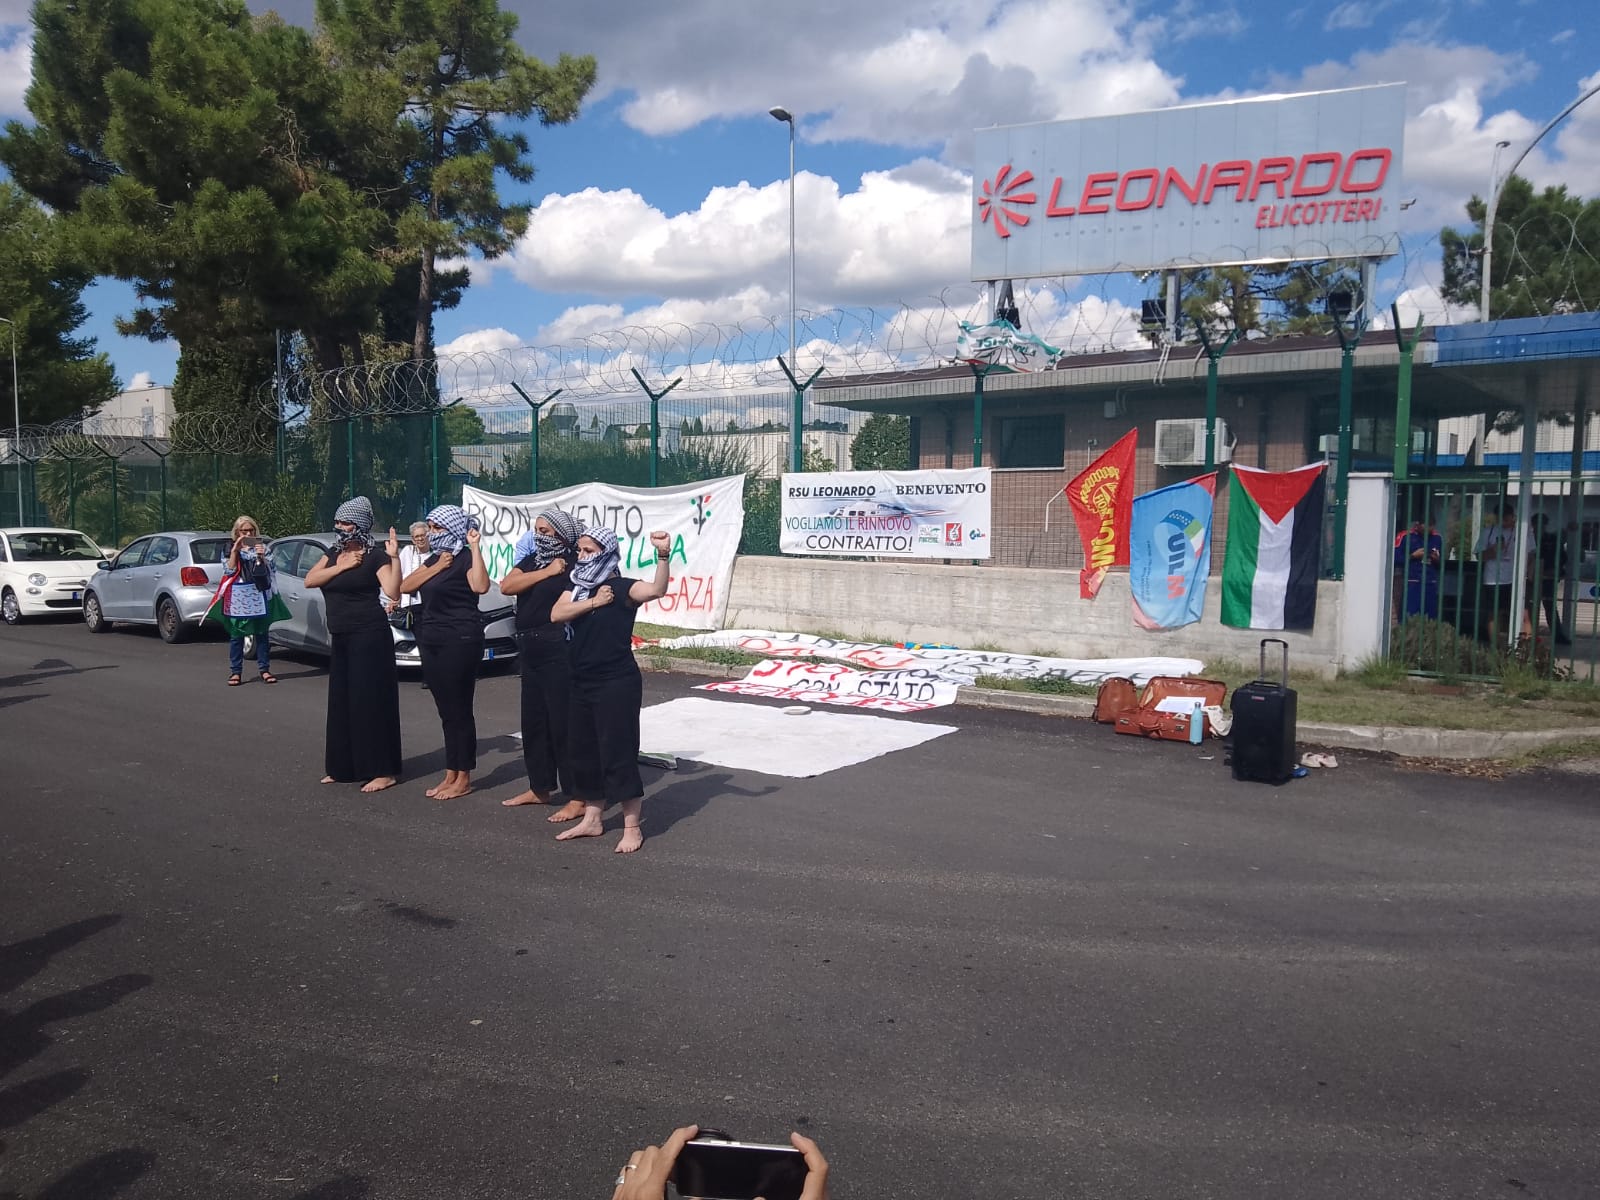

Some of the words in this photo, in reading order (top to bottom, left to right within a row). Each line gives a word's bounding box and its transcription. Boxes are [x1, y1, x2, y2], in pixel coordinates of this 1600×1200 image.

[1046, 147, 1392, 217] LEONARDO
[1255, 197, 1382, 229] ELICOTTERI
[788, 487, 809, 498] RSU
[813, 485, 876, 497] LEONARDO
[895, 482, 986, 495] BENEVENTO
[467, 503, 531, 537] BUON
[845, 515, 855, 531] IL
[858, 514, 913, 531] RINNOVO
[806, 534, 913, 551] CONTRATTO!
[1168, 532, 1186, 600] UILM
[658, 576, 713, 612] GAZA
